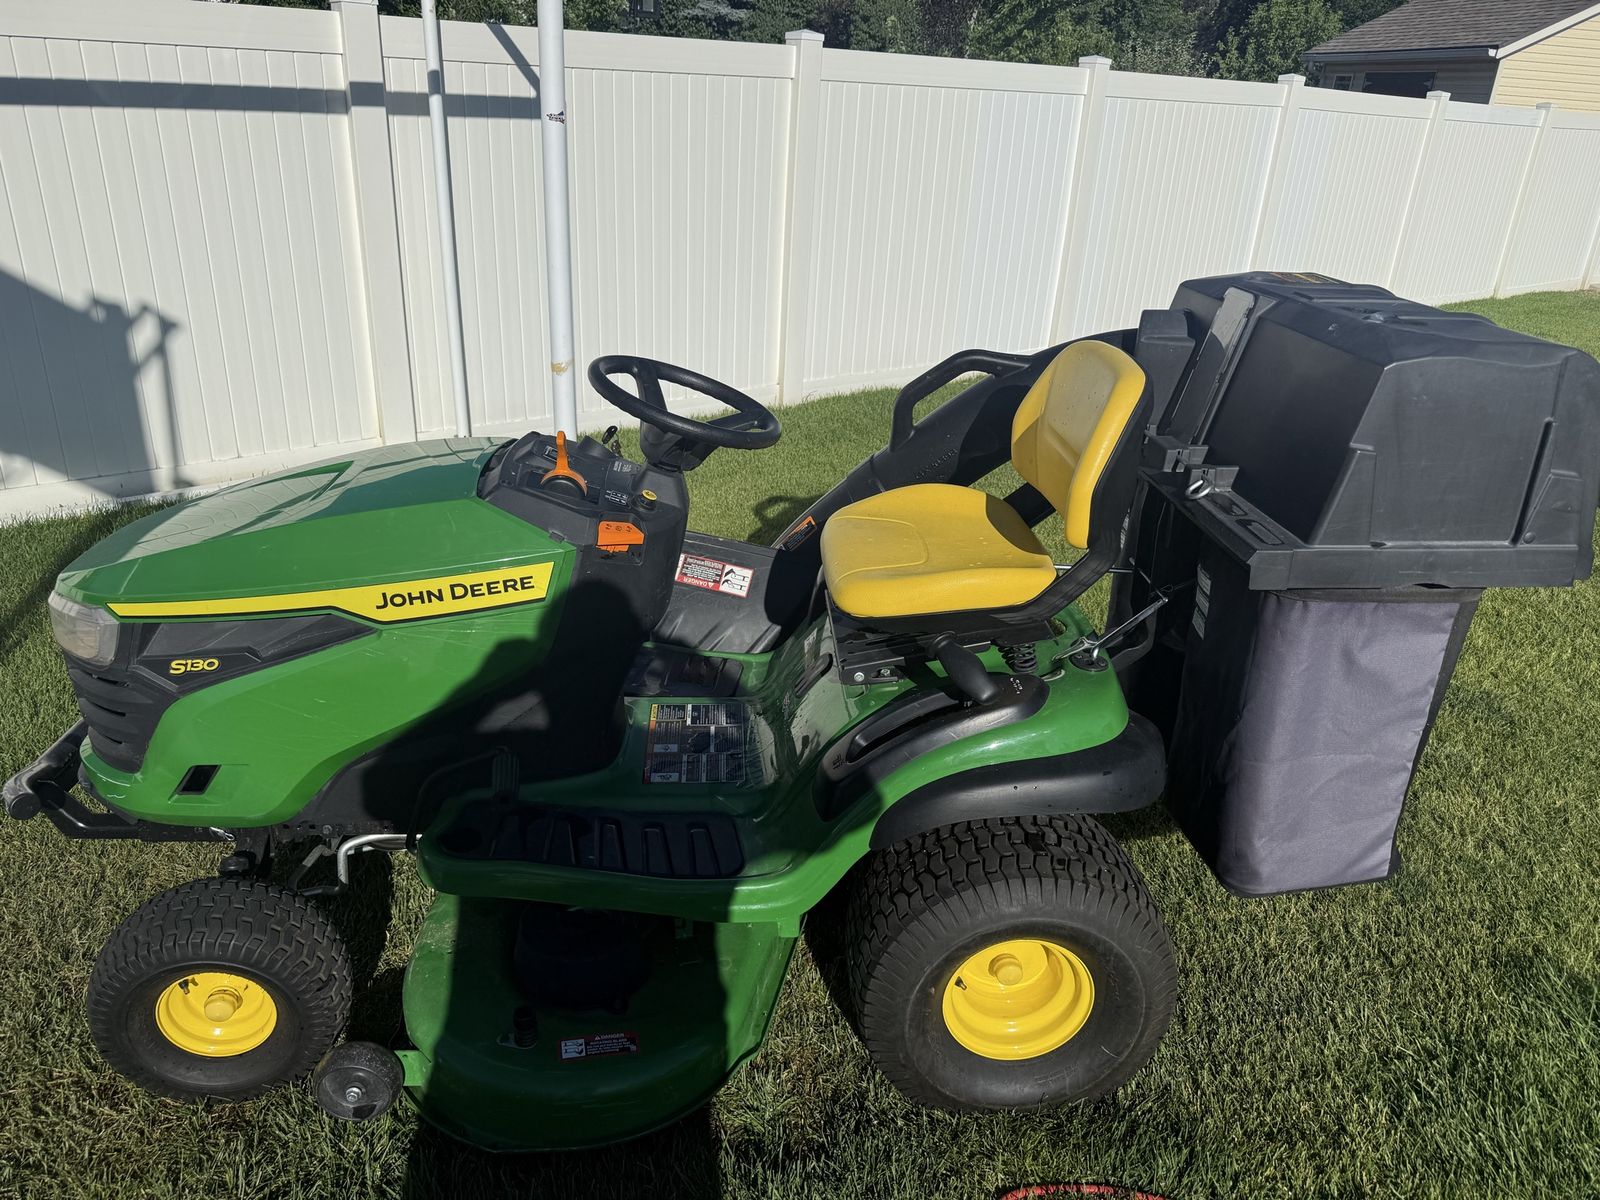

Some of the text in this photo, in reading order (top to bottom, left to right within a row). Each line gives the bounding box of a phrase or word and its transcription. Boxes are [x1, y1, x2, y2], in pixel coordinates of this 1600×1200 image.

[376, 575, 535, 609] JOHN DEERE
[169, 658, 220, 675] S130
